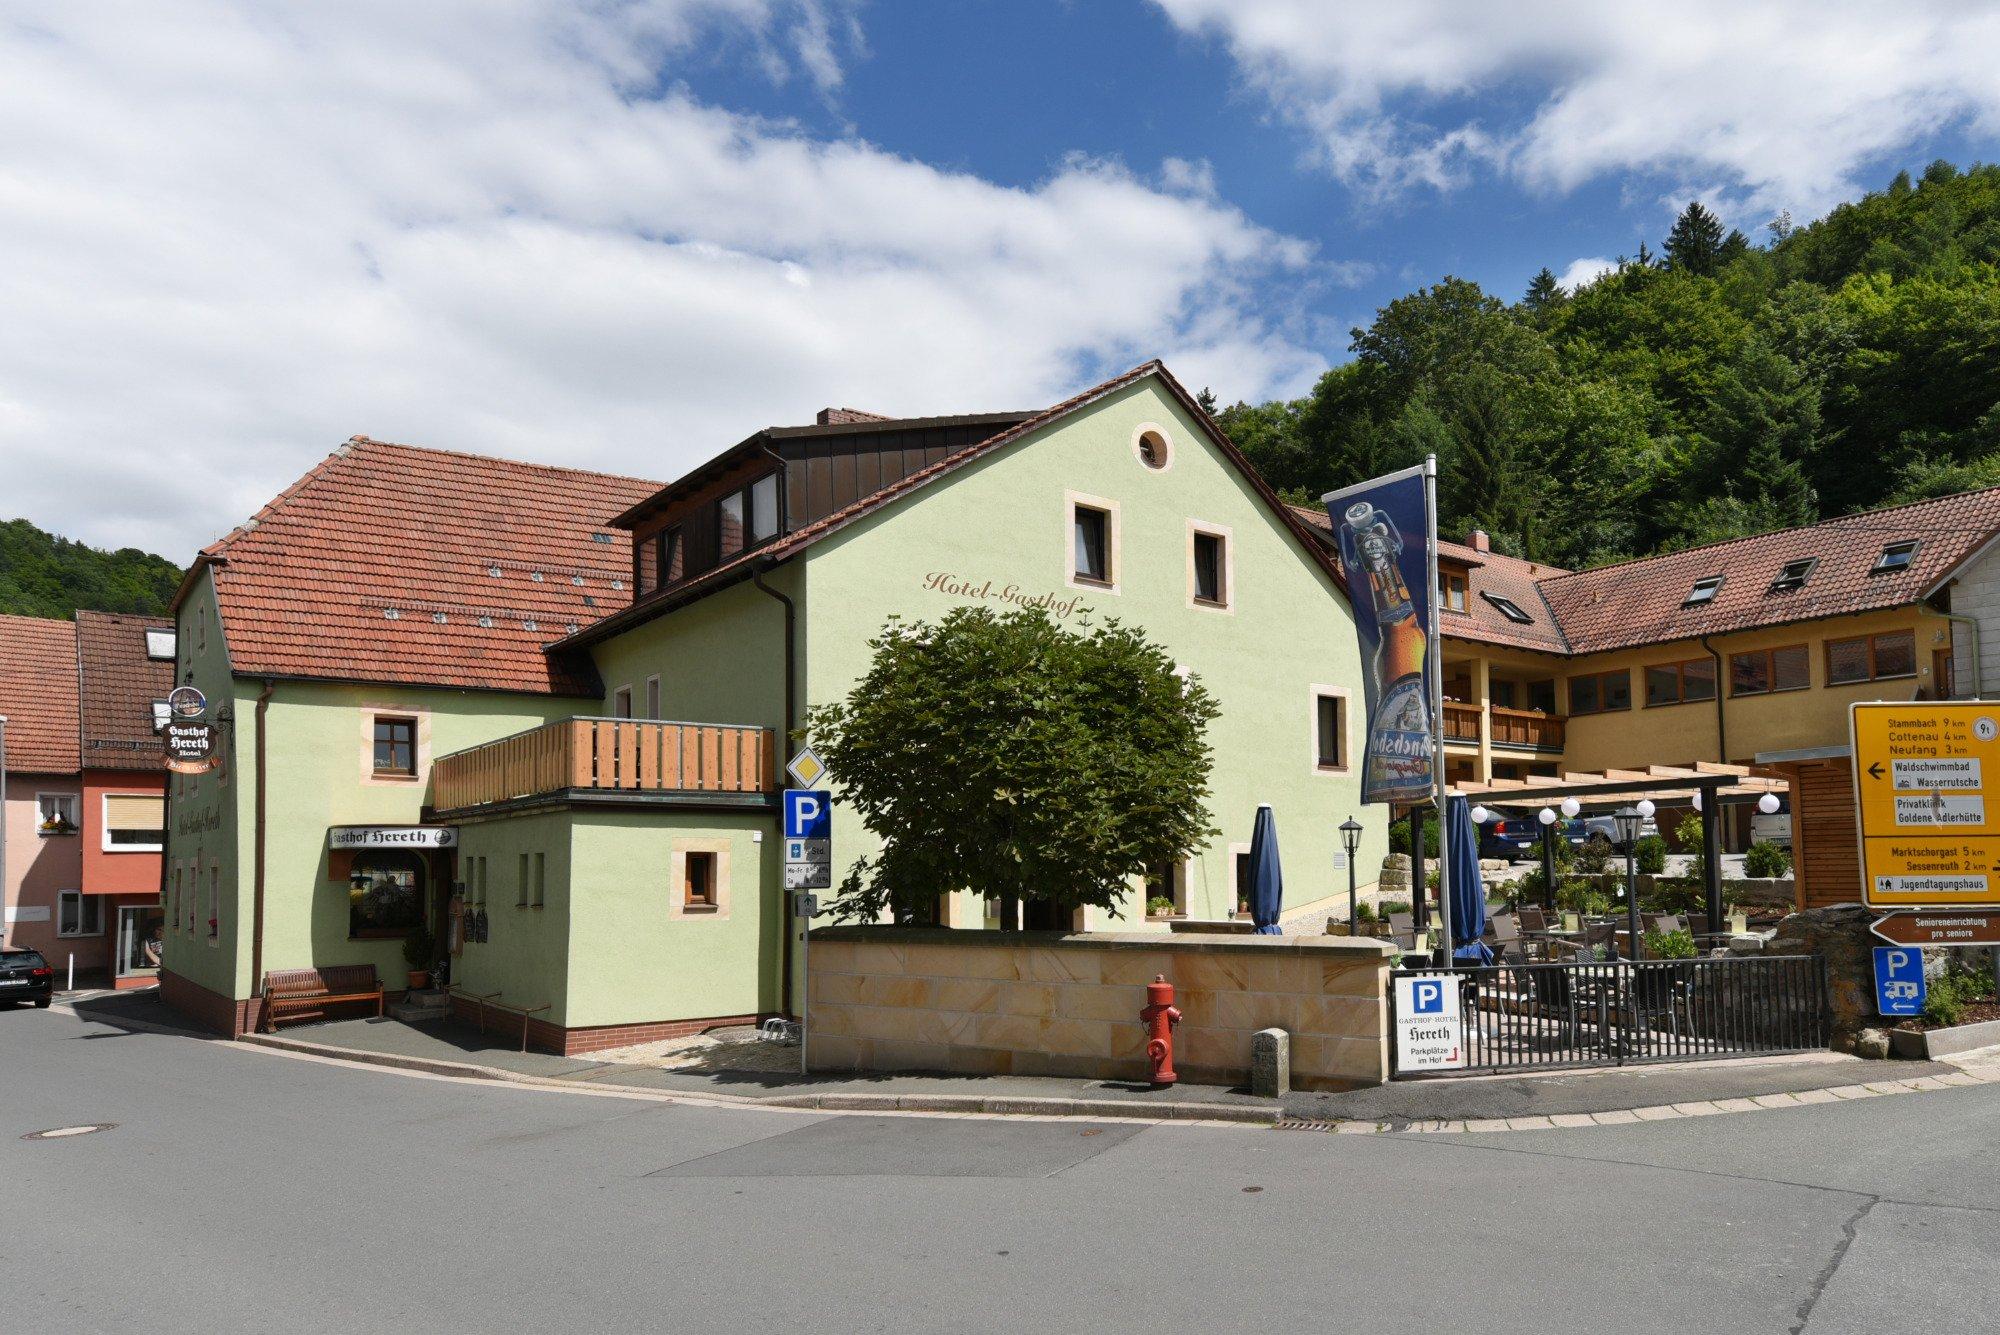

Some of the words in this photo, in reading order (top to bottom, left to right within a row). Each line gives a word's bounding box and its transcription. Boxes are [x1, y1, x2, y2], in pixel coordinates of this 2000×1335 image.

[923, 572, 1083, 619] Hotel-Gasthof
[1888, 718, 1937, 728] Stammbach
[1943, 718, 1950, 727] 9
[168, 726, 209, 737] Gasthof
[1889, 732, 1938, 741] Cottenau
[1944, 731, 1951, 740] 4
[170, 737, 209, 750] Hereth
[1889, 745, 1937, 756] Neufang
[1945, 744, 1952, 754] 3
[1895, 762, 1970, 772] Waldschwimmbad
[1917, 778, 1979, 787] Wasserrutsche
[1897, 799, 1946, 809] Privatklinik
[795, 796, 820, 834] P
[1898, 813, 1932, 823] Goldene
[1937, 812, 1982, 822] Adlerhütte
[372, 829, 427, 844] Hereth
[1892, 847, 1958, 858] Marktschorgast
[1963, 846, 1970, 856] 5
[1907, 861, 1959, 871] Sessenreuth
[1964, 861, 1971, 870] 2
[1973, 863, 1987, 871] km
[1900, 879, 1984, 891] Jugendtagungshaus
[1915, 918, 1987, 927] Senioreneinrichtung
[1947, 929, 1973, 937] seniore
[1887, 951, 1909, 978] P
[1418, 984, 1438, 1010] P
[1409, 1026, 1450, 1042] Hereth
[1411, 1047, 1449, 1056] Parkplätze
